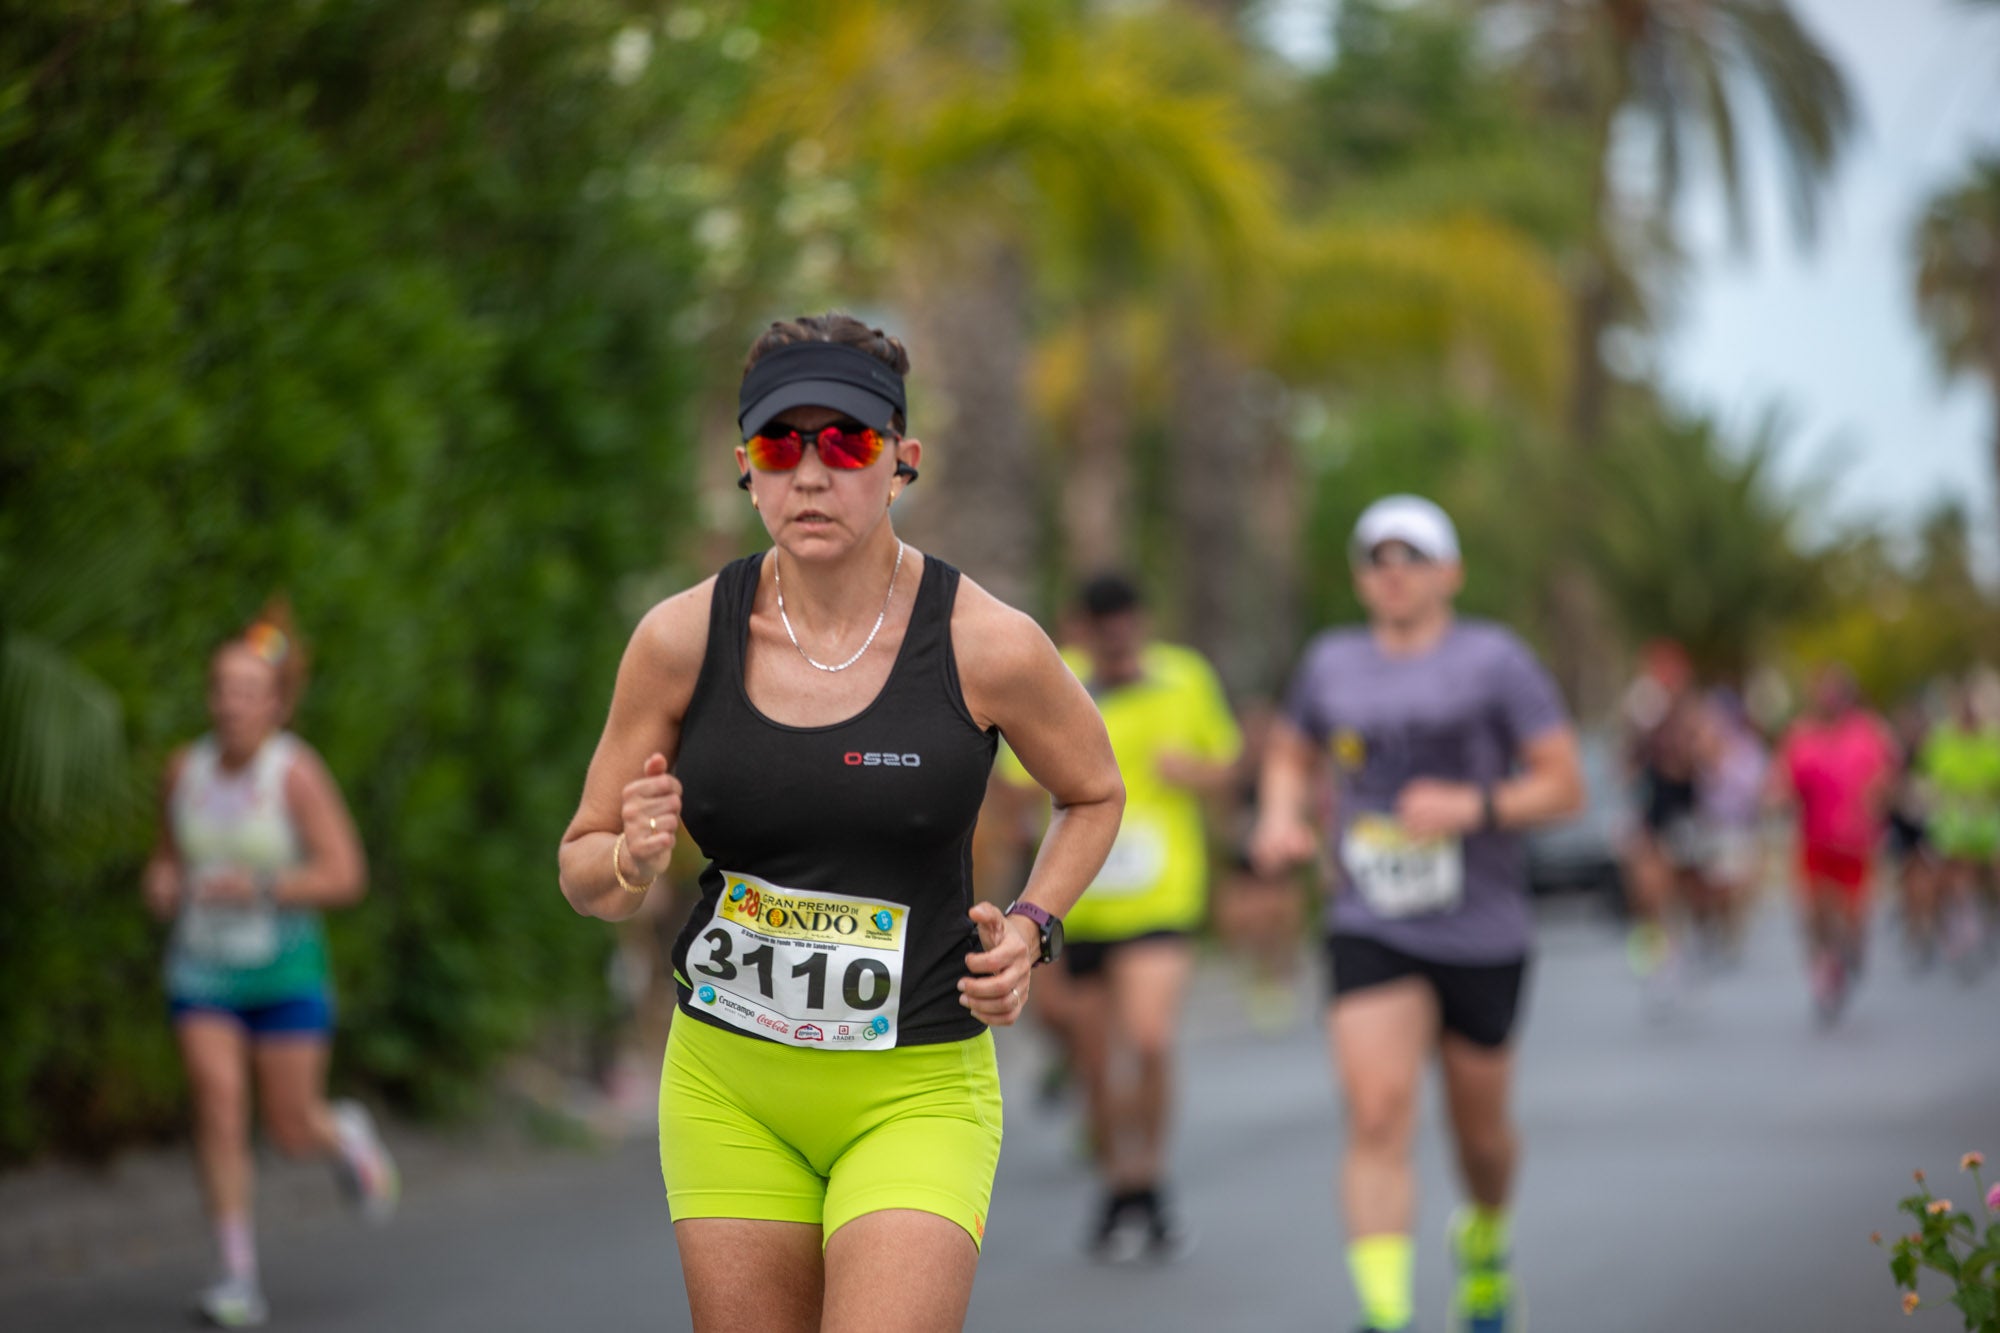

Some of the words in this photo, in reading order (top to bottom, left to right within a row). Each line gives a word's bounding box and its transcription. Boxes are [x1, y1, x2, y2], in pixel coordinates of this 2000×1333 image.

[738, 888, 760, 917] 38
[763, 894, 794, 909] GRAN
[797, 902, 850, 914] PREMIO
[756, 902, 858, 935] FONDO
[694, 927, 891, 1011] 3110
[718, 995, 755, 1018] Cruzcampo
